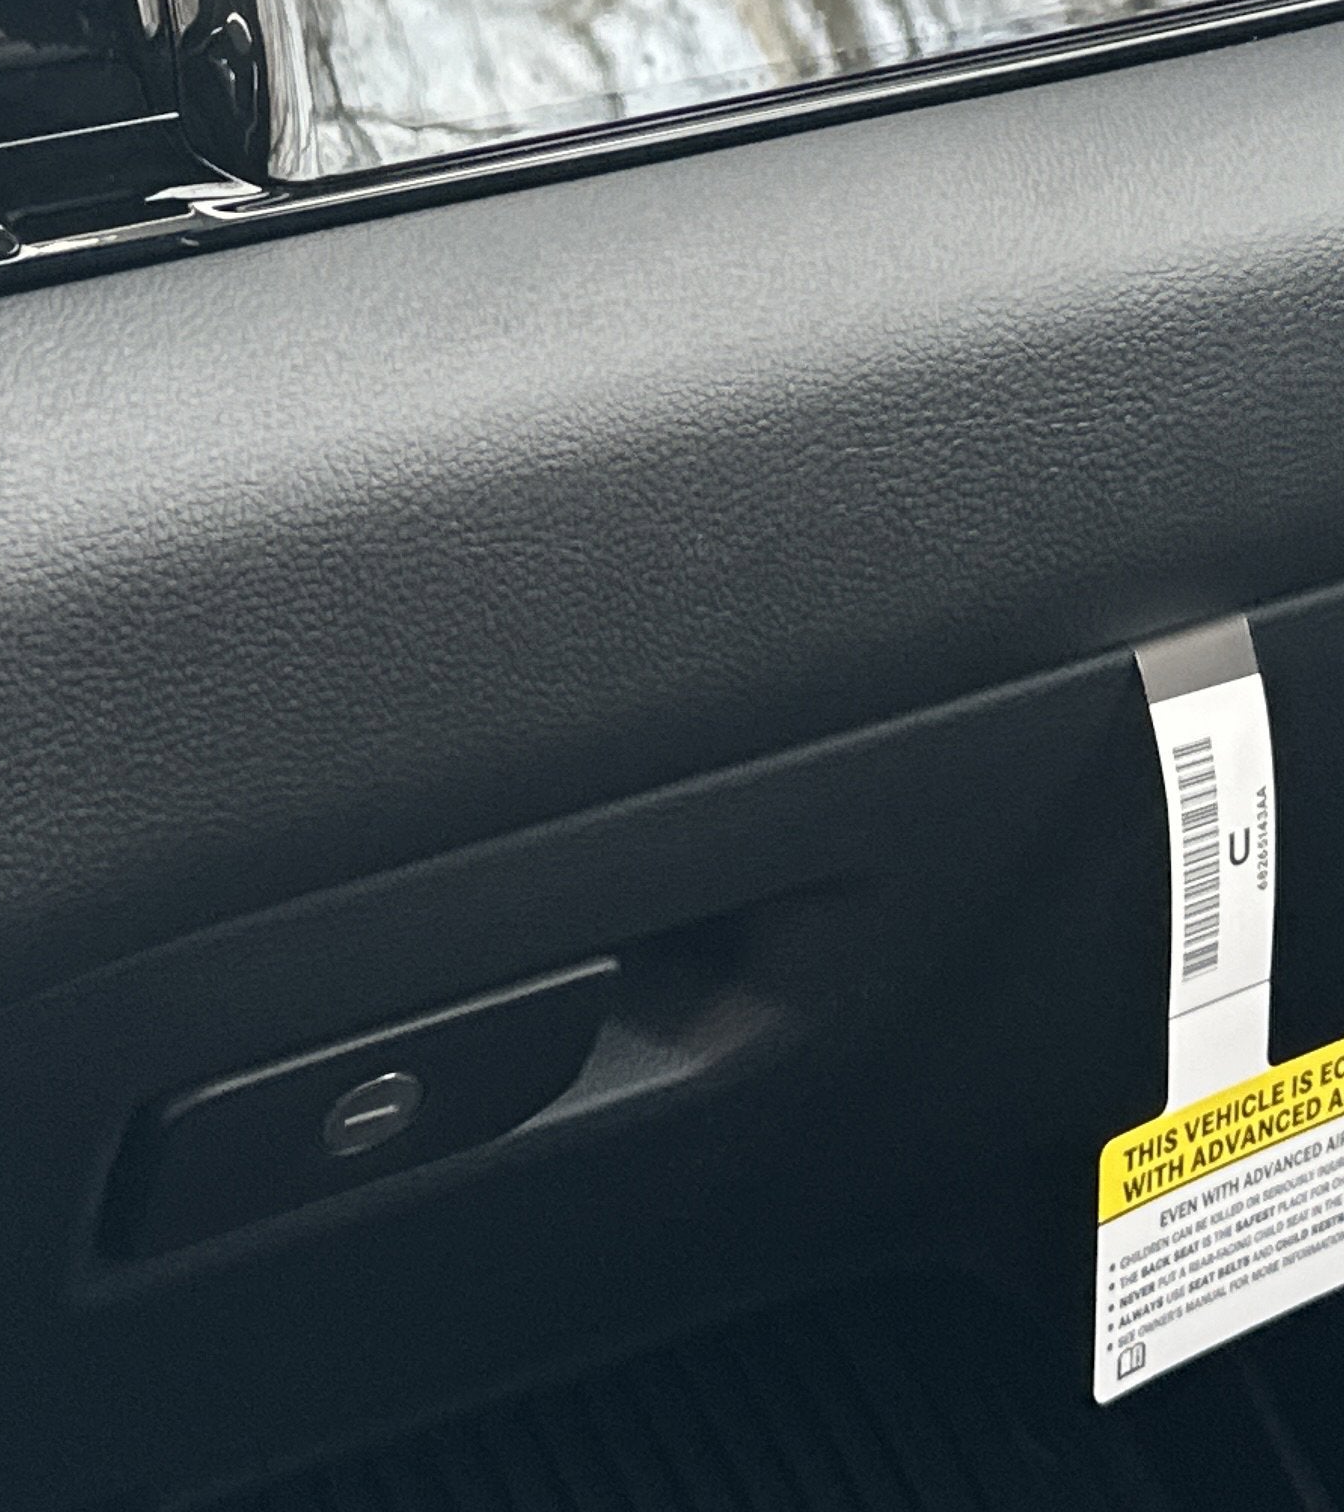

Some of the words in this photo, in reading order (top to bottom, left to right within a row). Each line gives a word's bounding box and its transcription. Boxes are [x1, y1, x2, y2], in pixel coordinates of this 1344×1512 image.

[1229, 827, 1250, 865] U
[1123, 1128, 1178, 1172] THIS
[1184, 1081, 1284, 1142] VEHICLE
[1291, 1070, 1313, 1098] IS
[1123, 1154, 1184, 1203] WITH
[1191, 1097, 1321, 1172] ADVANCED
[1160, 1197, 1198, 1228] EVEN
[1202, 1177, 1240, 1207] WITH
[1243, 1142, 1323, 1188] ADVANCED
